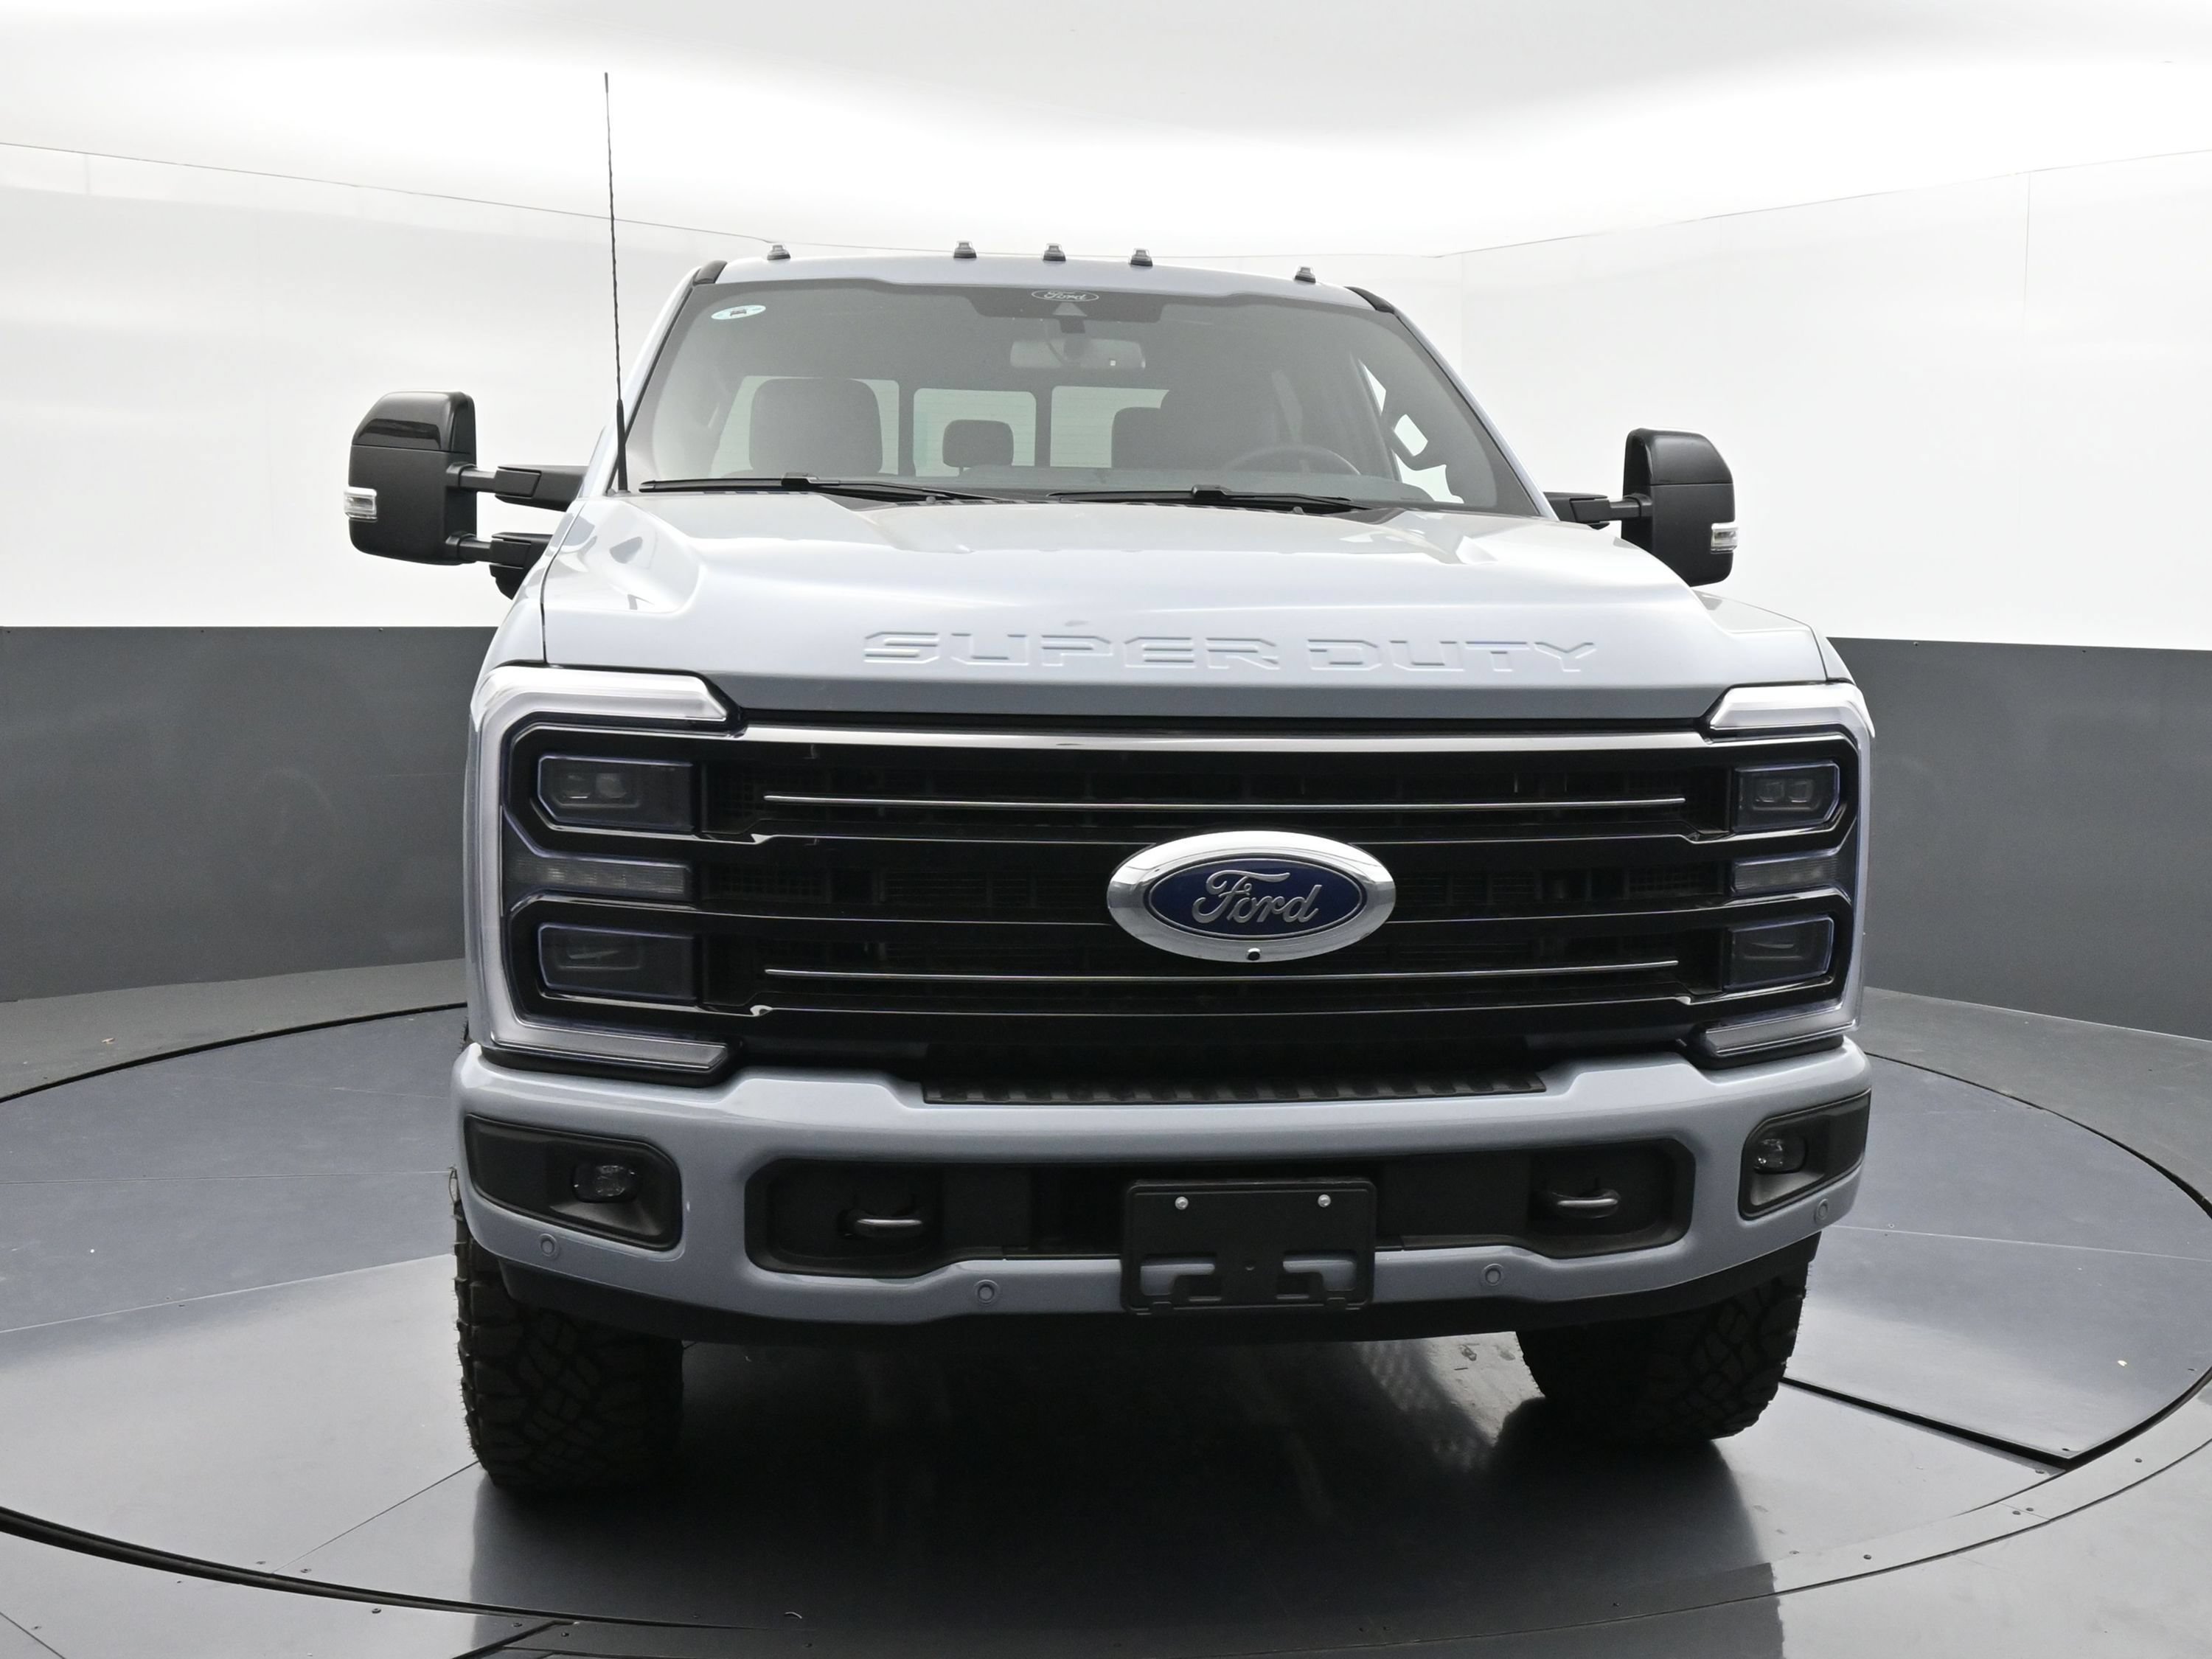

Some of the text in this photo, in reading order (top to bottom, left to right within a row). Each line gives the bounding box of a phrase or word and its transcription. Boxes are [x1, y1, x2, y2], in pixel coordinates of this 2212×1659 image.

[1043, 291, 1086, 301] Ford
[863, 630, 1596, 672] SUPER DUTY
[1192, 869, 1322, 923] Ford
